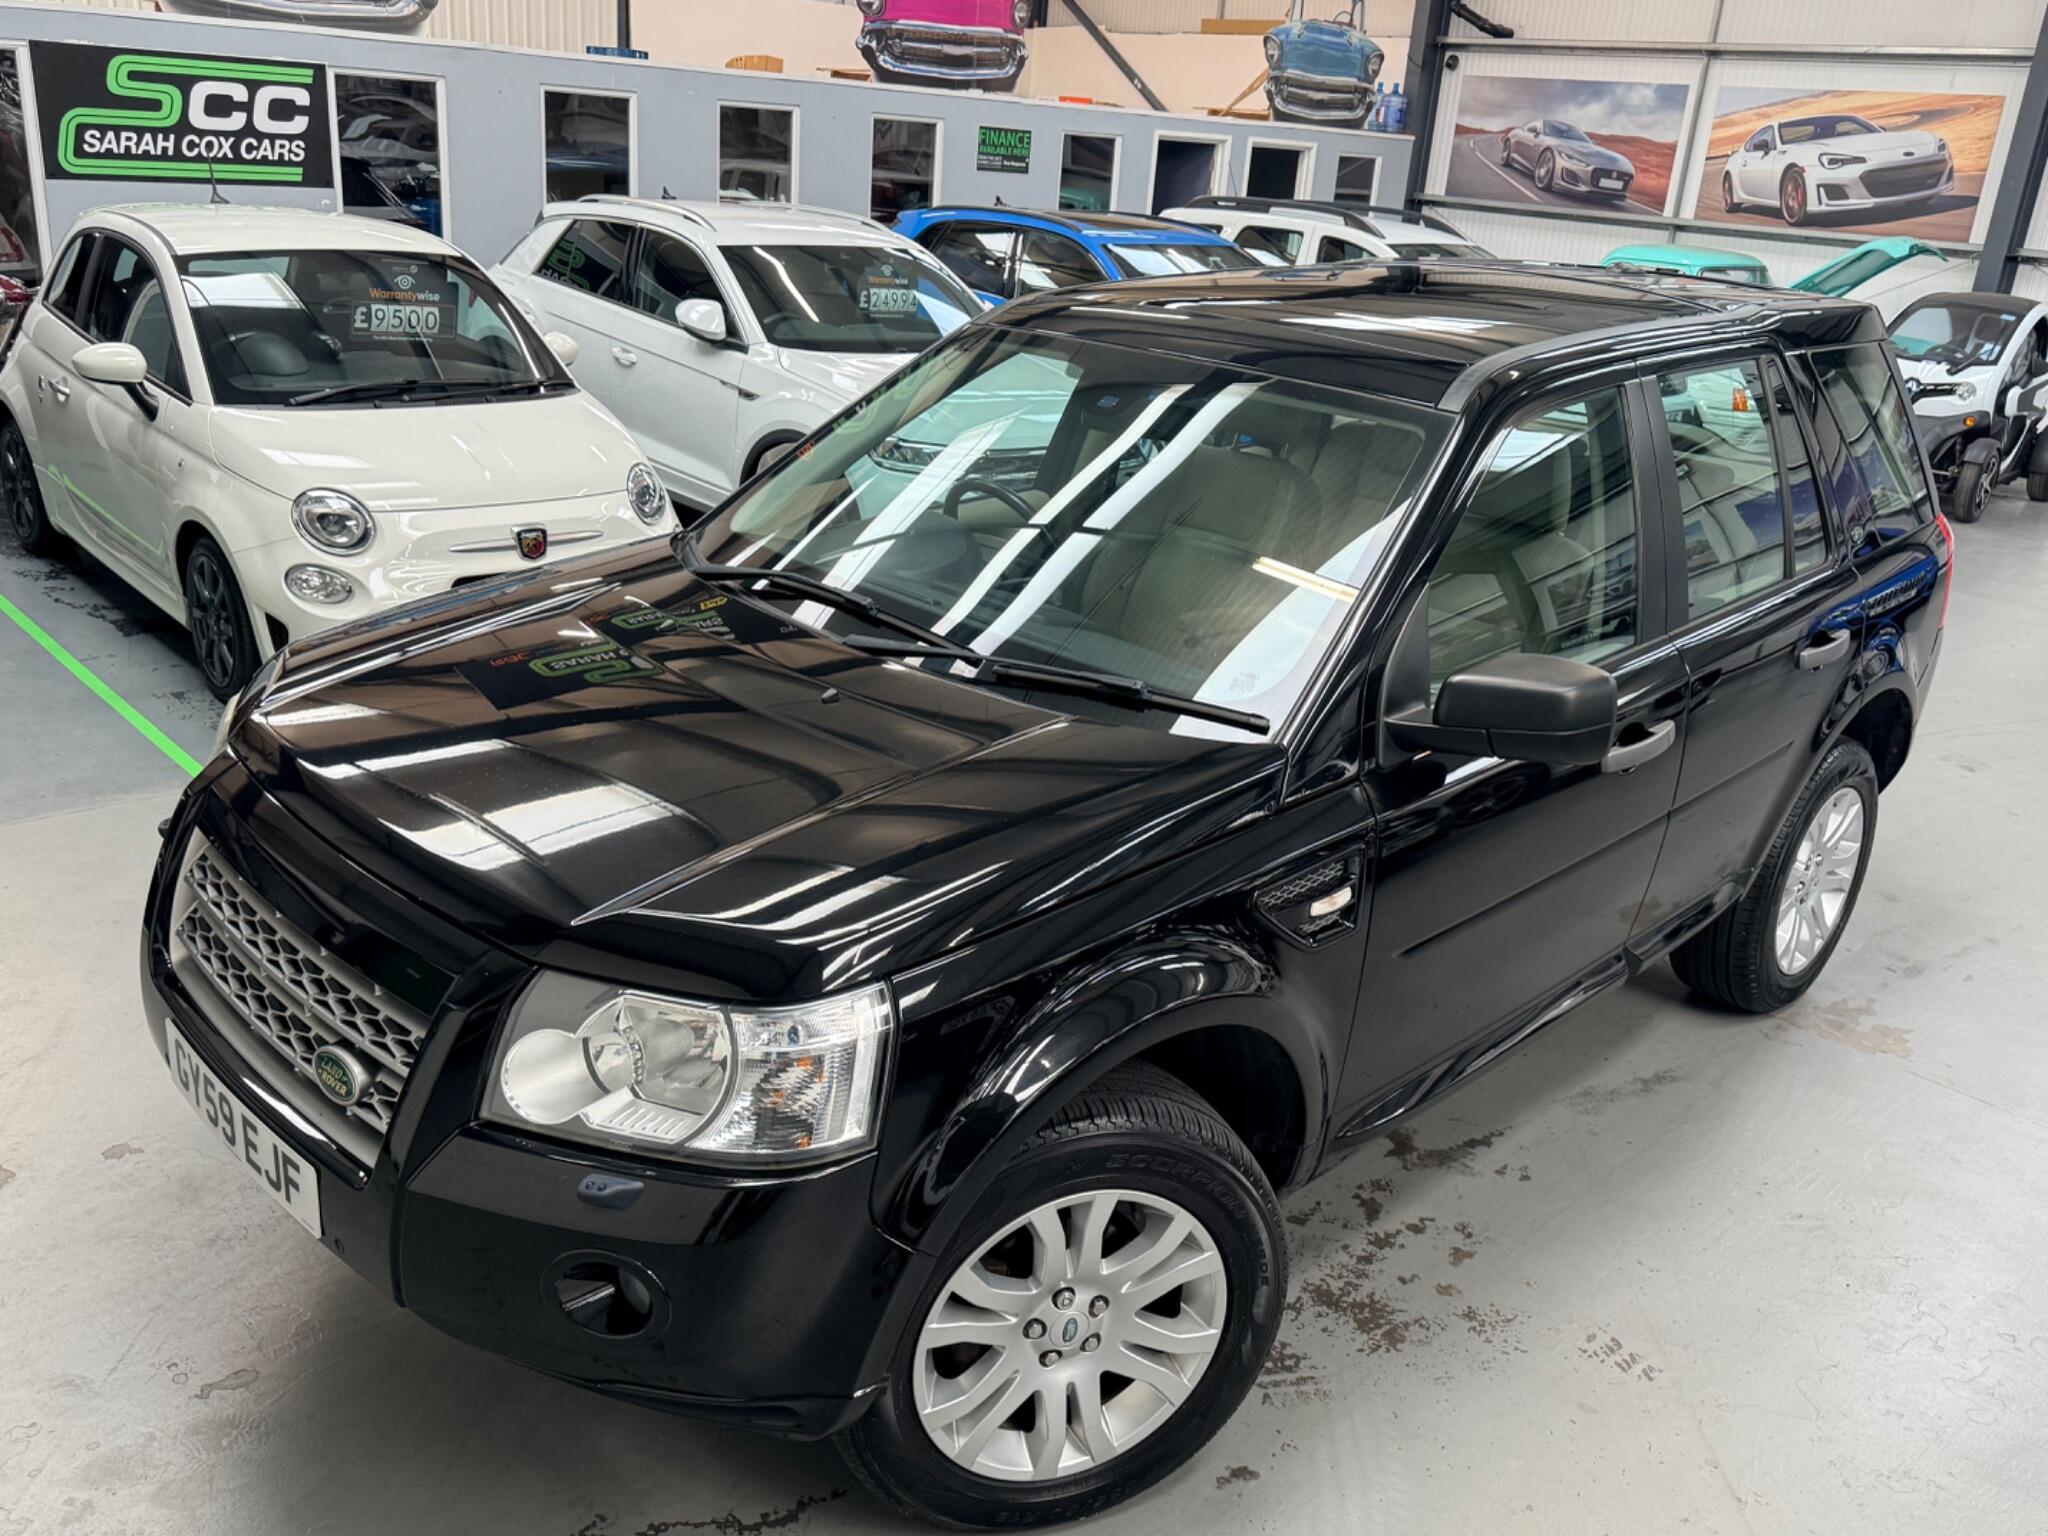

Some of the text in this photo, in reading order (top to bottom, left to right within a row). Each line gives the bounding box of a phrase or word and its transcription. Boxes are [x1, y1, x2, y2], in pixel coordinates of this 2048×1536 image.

[82, 129, 306, 162] SARAH COX CARS
[979, 128, 1031, 149] FINANCE
[369, 287, 440, 301] Warrantywise
[354, 305, 438, 330] £9500
[321, 1060, 343, 1079] LAND
[321, 1070, 347, 1095] ROVER
[174, 1038, 301, 1204] GY59 EJF
